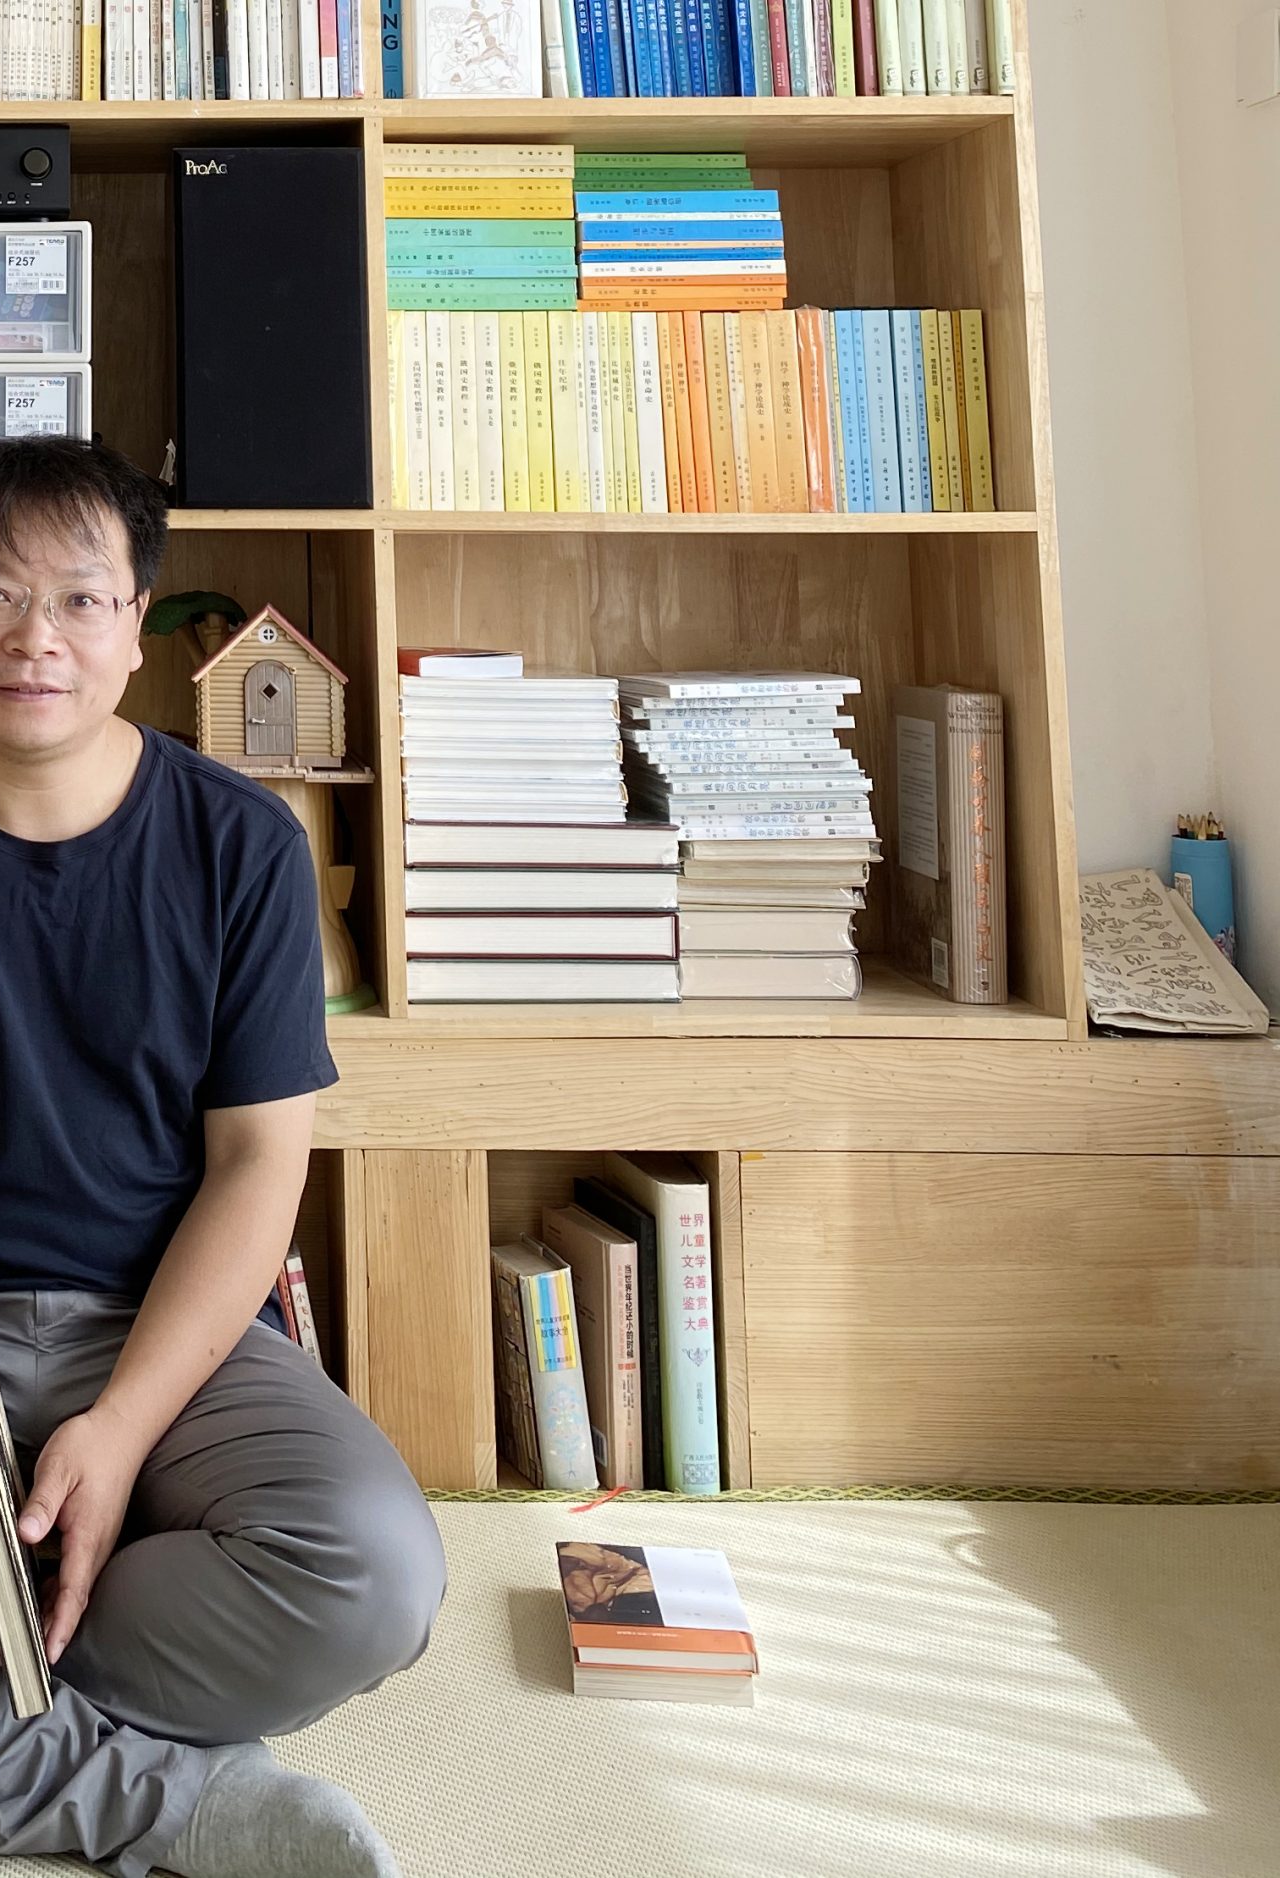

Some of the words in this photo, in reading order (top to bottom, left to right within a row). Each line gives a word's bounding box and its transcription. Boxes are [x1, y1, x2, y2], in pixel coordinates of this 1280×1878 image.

[185, 160, 228, 175] ProAc
[8, 257, 36, 266] F257
[8, 398, 36, 408] F257
[678, 1213, 705, 1227] 世界
[680, 1234, 706, 1248] 儿童
[682, 1254, 707, 1268] 文学
[682, 1275, 707, 1290] 名著
[682, 1295, 708, 1311] 鉴赏
[624, 1264, 634, 1359] 当世界年纪还小的时候
[684, 1317, 709, 1332] 大典
